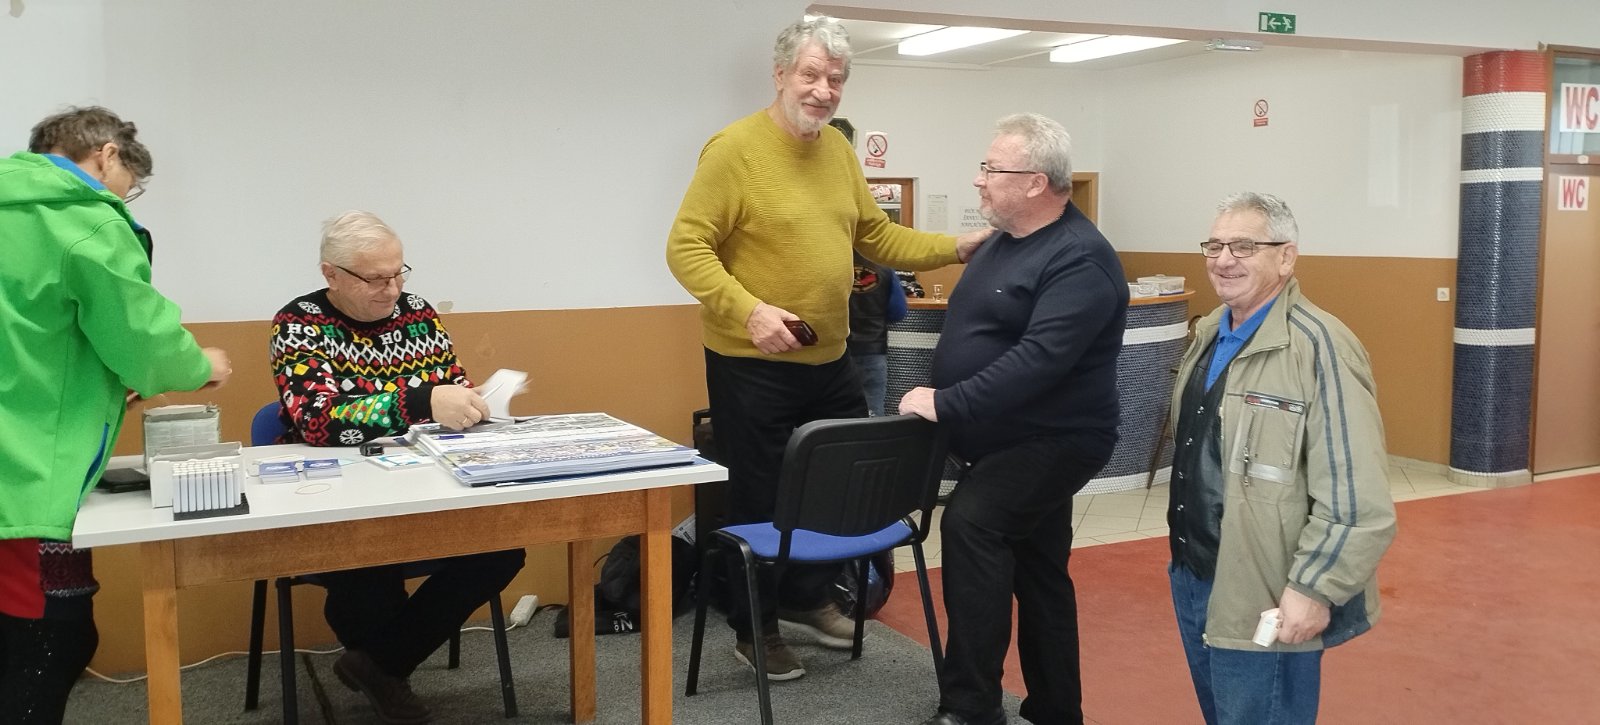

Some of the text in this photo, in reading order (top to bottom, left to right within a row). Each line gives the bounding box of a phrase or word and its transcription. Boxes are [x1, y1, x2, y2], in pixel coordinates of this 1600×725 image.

[1565, 86, 1599, 130] WC
[1563, 178, 1585, 208] WC
[287, 323, 317, 337] HO
[379, 329, 402, 345] HO
[407, 322, 429, 338] HO
